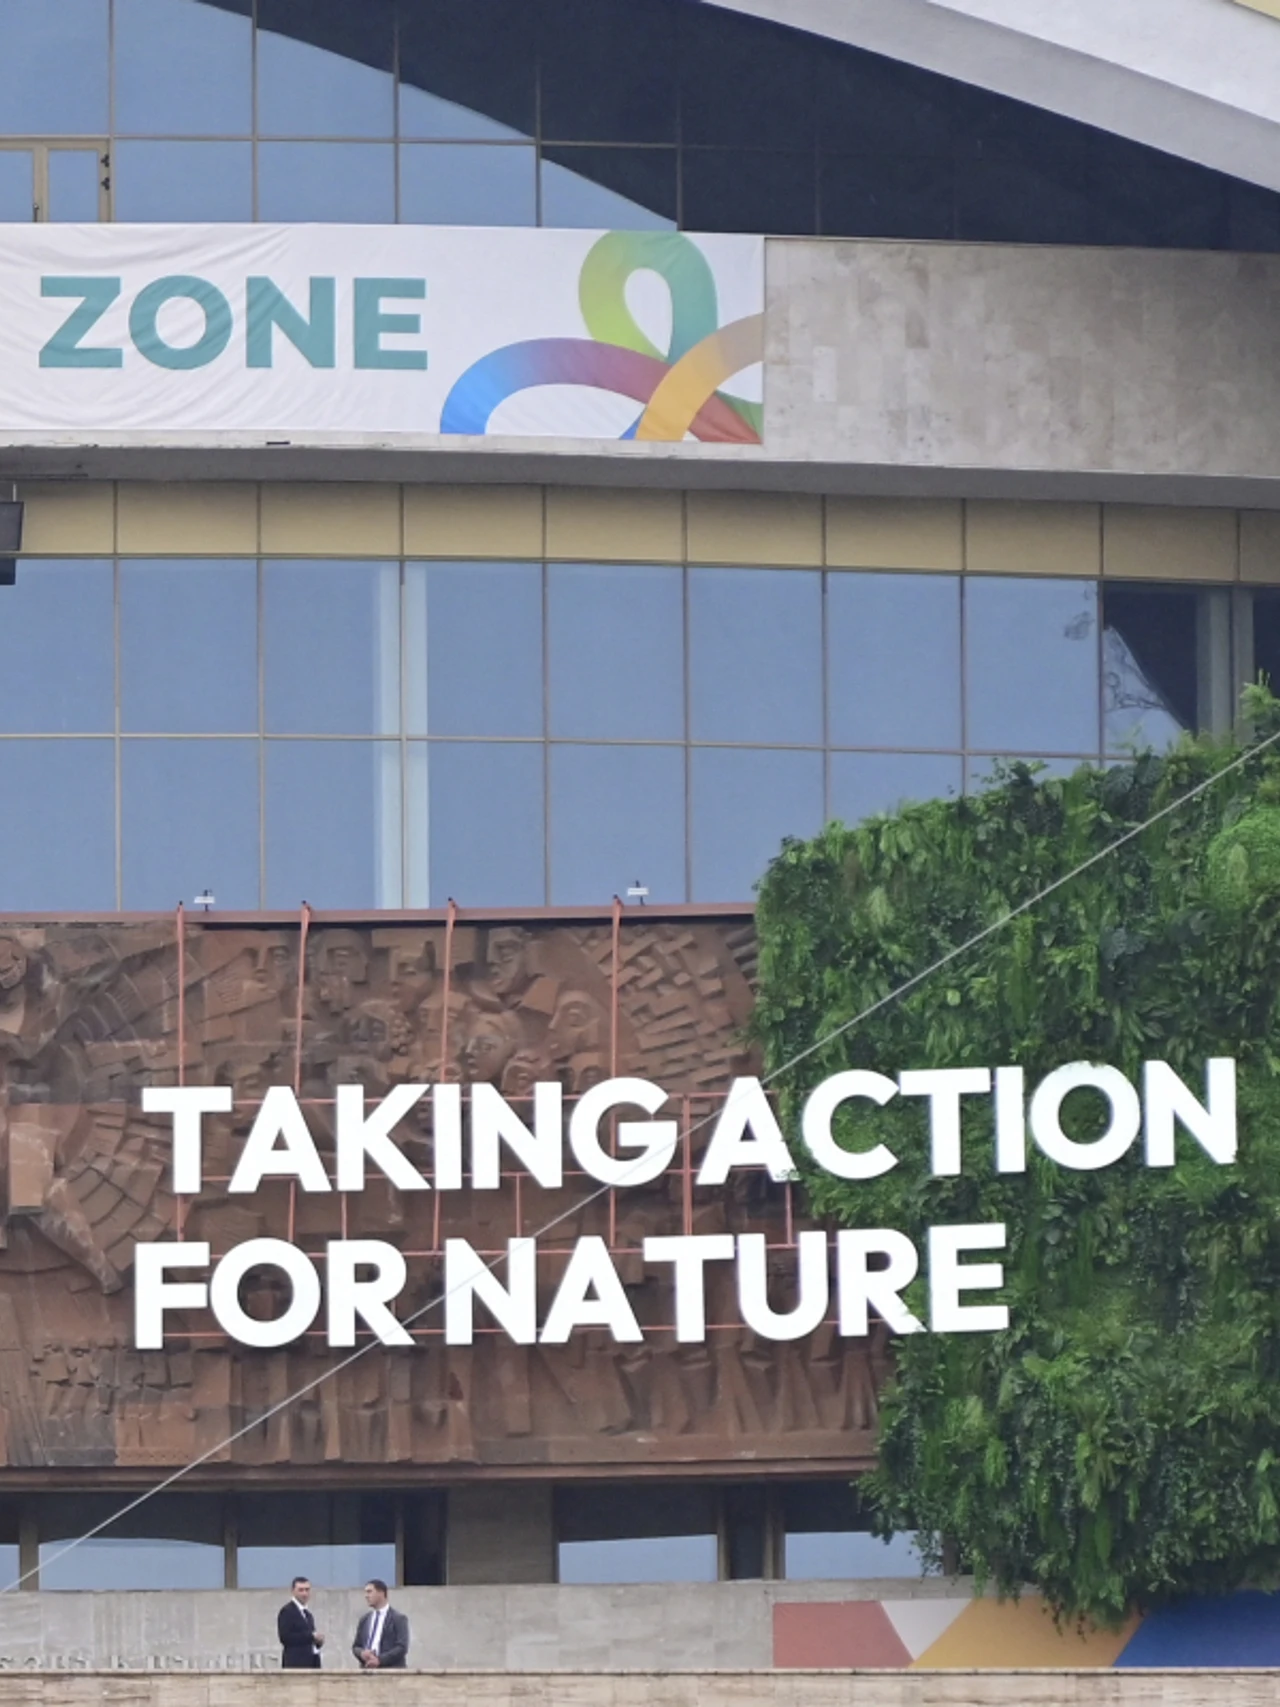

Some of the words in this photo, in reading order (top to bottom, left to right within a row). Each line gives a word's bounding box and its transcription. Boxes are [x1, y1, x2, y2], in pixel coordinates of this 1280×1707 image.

[39, 275, 428, 370] ZONE
[142, 1076, 678, 1194] TAKING
[696, 1057, 1238, 1185] ACTION
[135, 1238, 416, 1350] FOR
[444, 1223, 1010, 1345] NATURE
